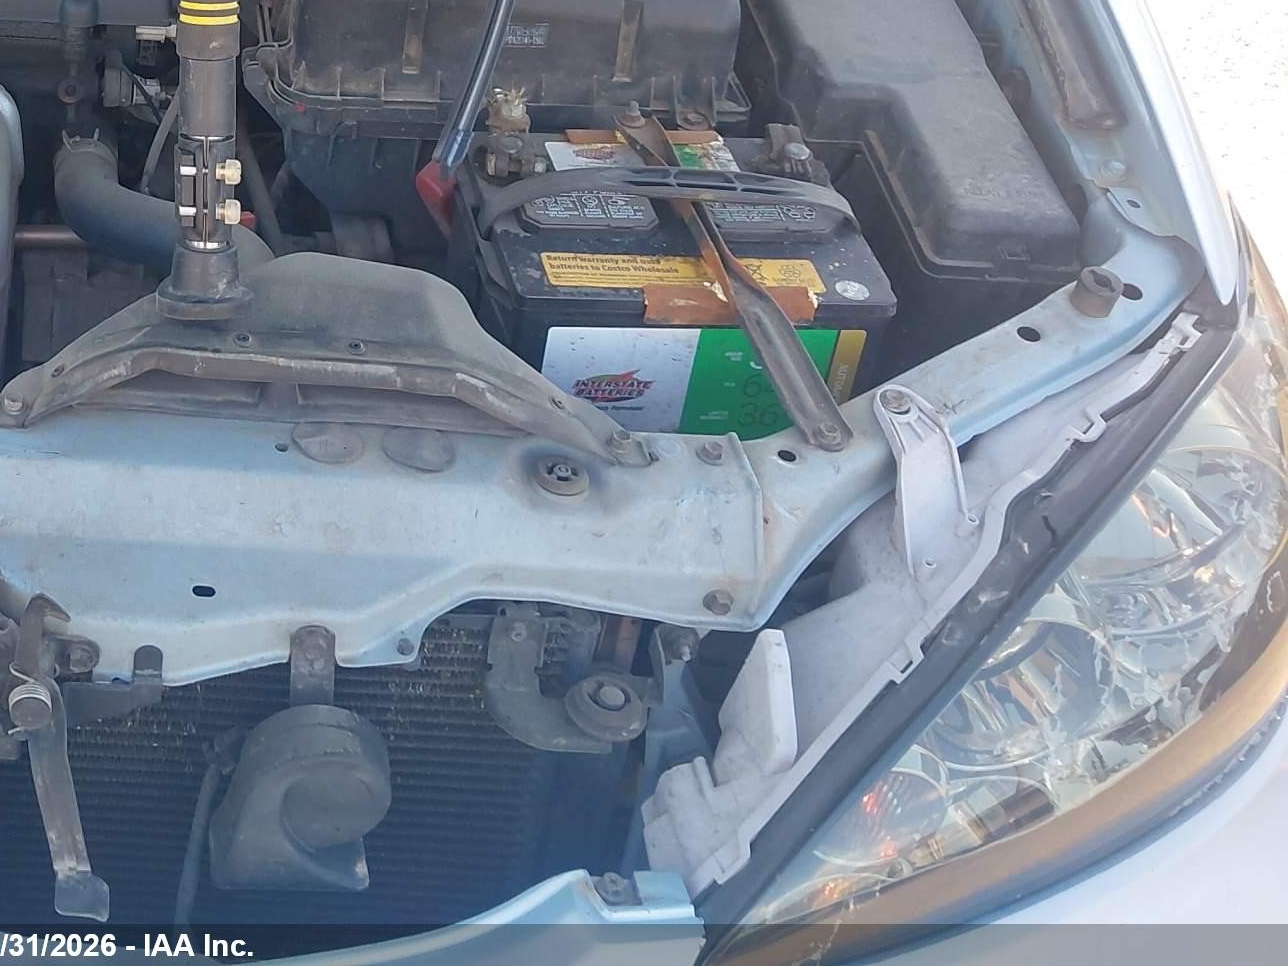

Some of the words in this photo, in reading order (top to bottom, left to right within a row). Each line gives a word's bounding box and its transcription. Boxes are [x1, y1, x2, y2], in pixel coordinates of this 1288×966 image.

[546, 254, 577, 263] Return
[577, 255, 619, 265] warranty
[621, 256, 637, 264] and
[549, 262, 589, 271] batteries
[591, 264, 601, 272] to
[602, 264, 631, 273] Costco
[633, 265, 679, 274] Wholesale
[573, 379, 652, 389] INTERSTATE
[575, 388, 646, 397] BATTERIES
